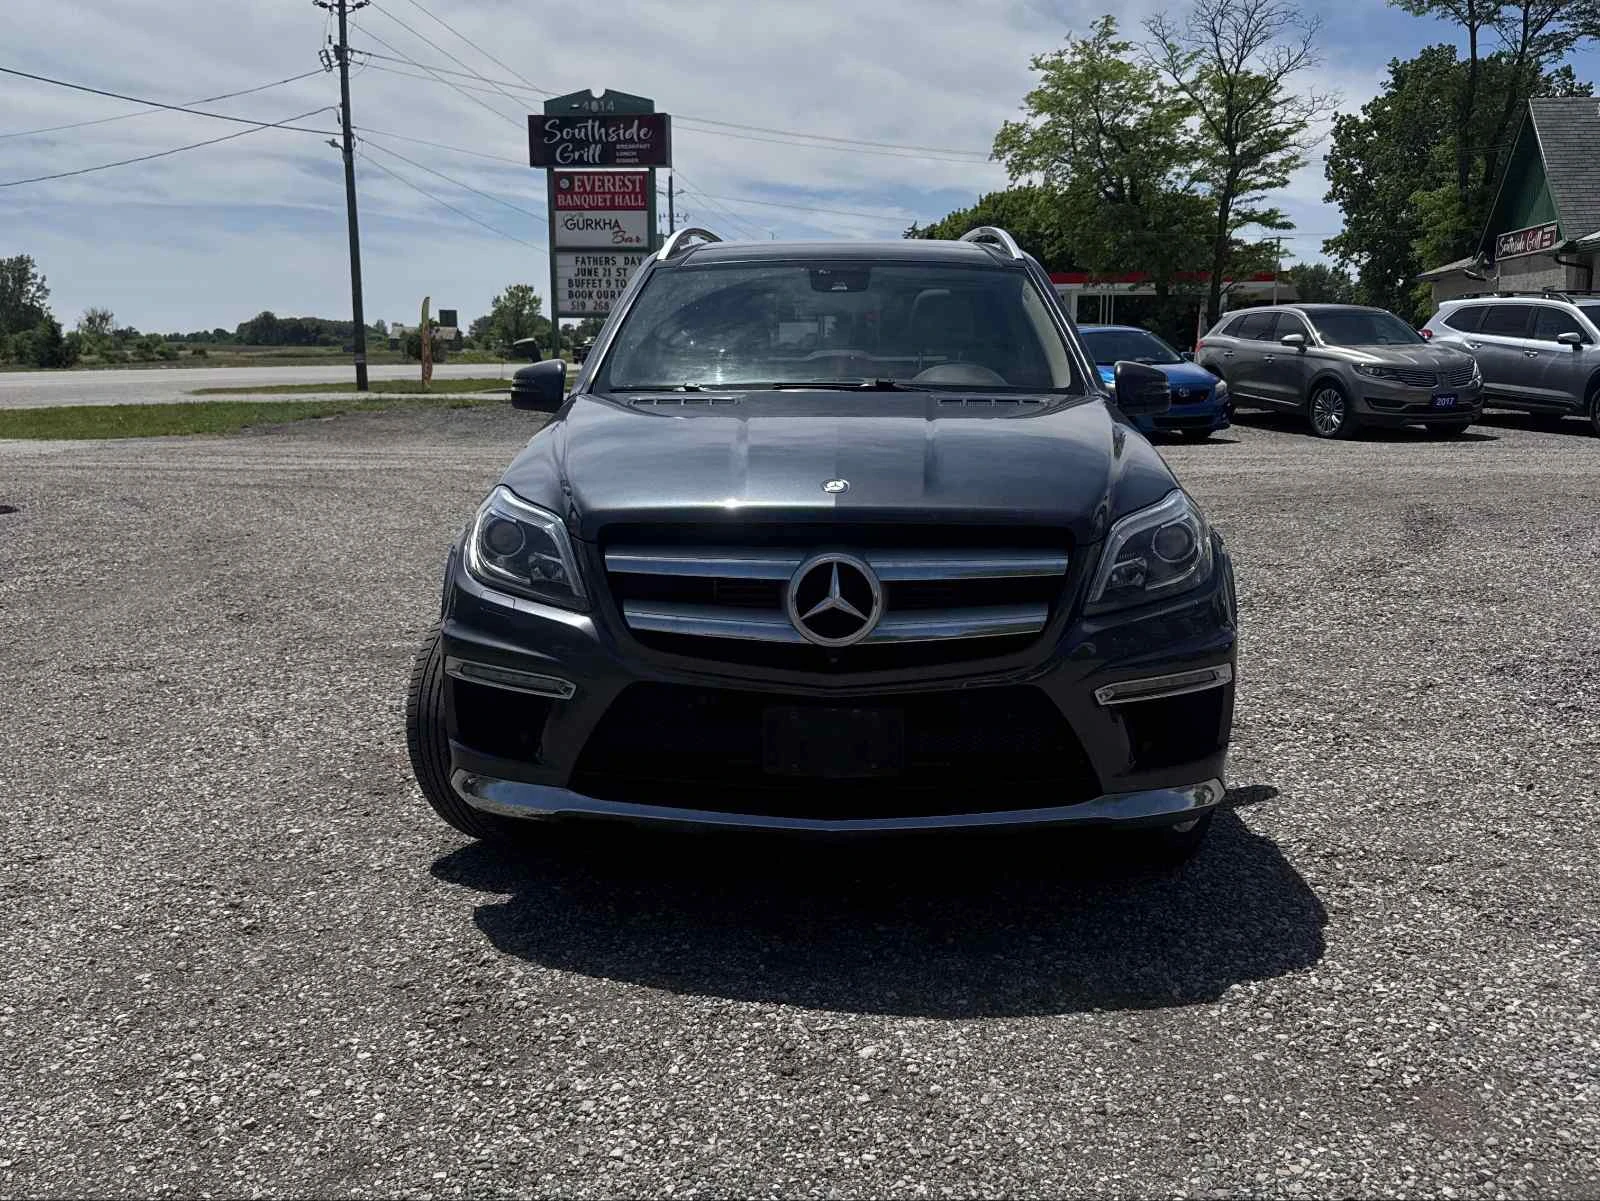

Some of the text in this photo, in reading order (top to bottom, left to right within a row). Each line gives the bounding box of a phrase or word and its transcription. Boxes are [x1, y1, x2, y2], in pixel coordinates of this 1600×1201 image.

[544, 119, 653, 144] Southside
[555, 143, 603, 164] Grill
[573, 175, 644, 193] EVEREST
[557, 194, 645, 208] BANQUET HALL
[564, 218, 622, 231] GURKHA
[612, 230, 641, 244] Bar
[575, 256, 643, 266] FATHERS DAY
[574, 267, 628, 277] JUNE 21 ST
[568, 279, 602, 288] BUFFET
[615, 279, 627, 288] TO
[568, 290, 593, 299] BOOK
[1436, 397, 1454, 406] 2017
